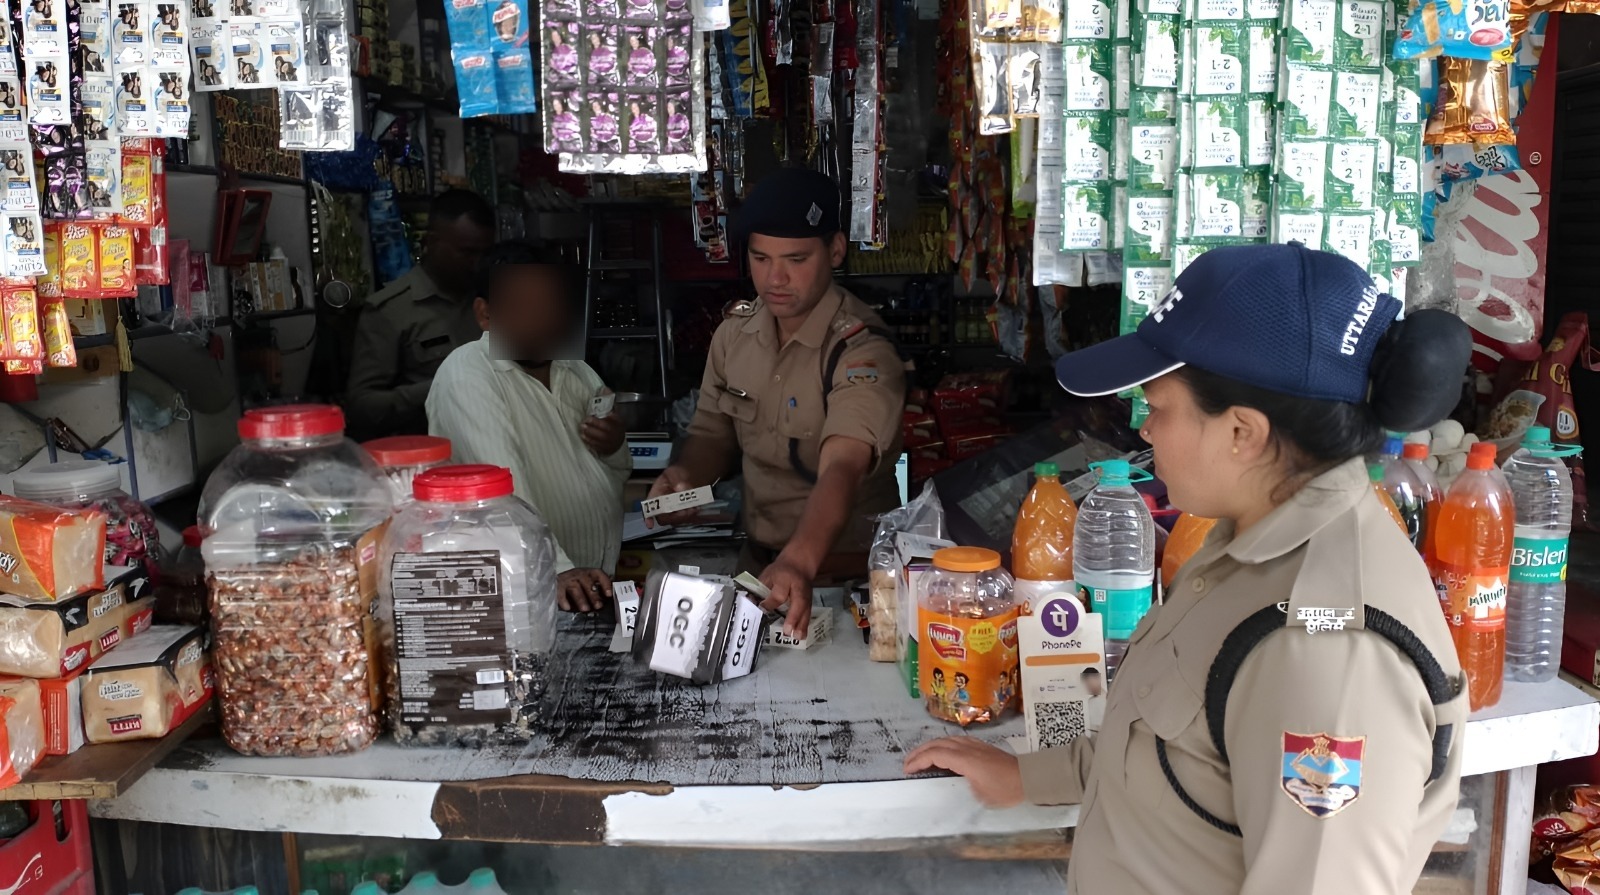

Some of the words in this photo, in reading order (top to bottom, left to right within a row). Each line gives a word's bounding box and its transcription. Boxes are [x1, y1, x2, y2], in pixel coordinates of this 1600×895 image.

[669, 597, 694, 650] OGC
[732, 618, 750, 667] OGC
[1041, 640, 1082, 650] PhonePe
